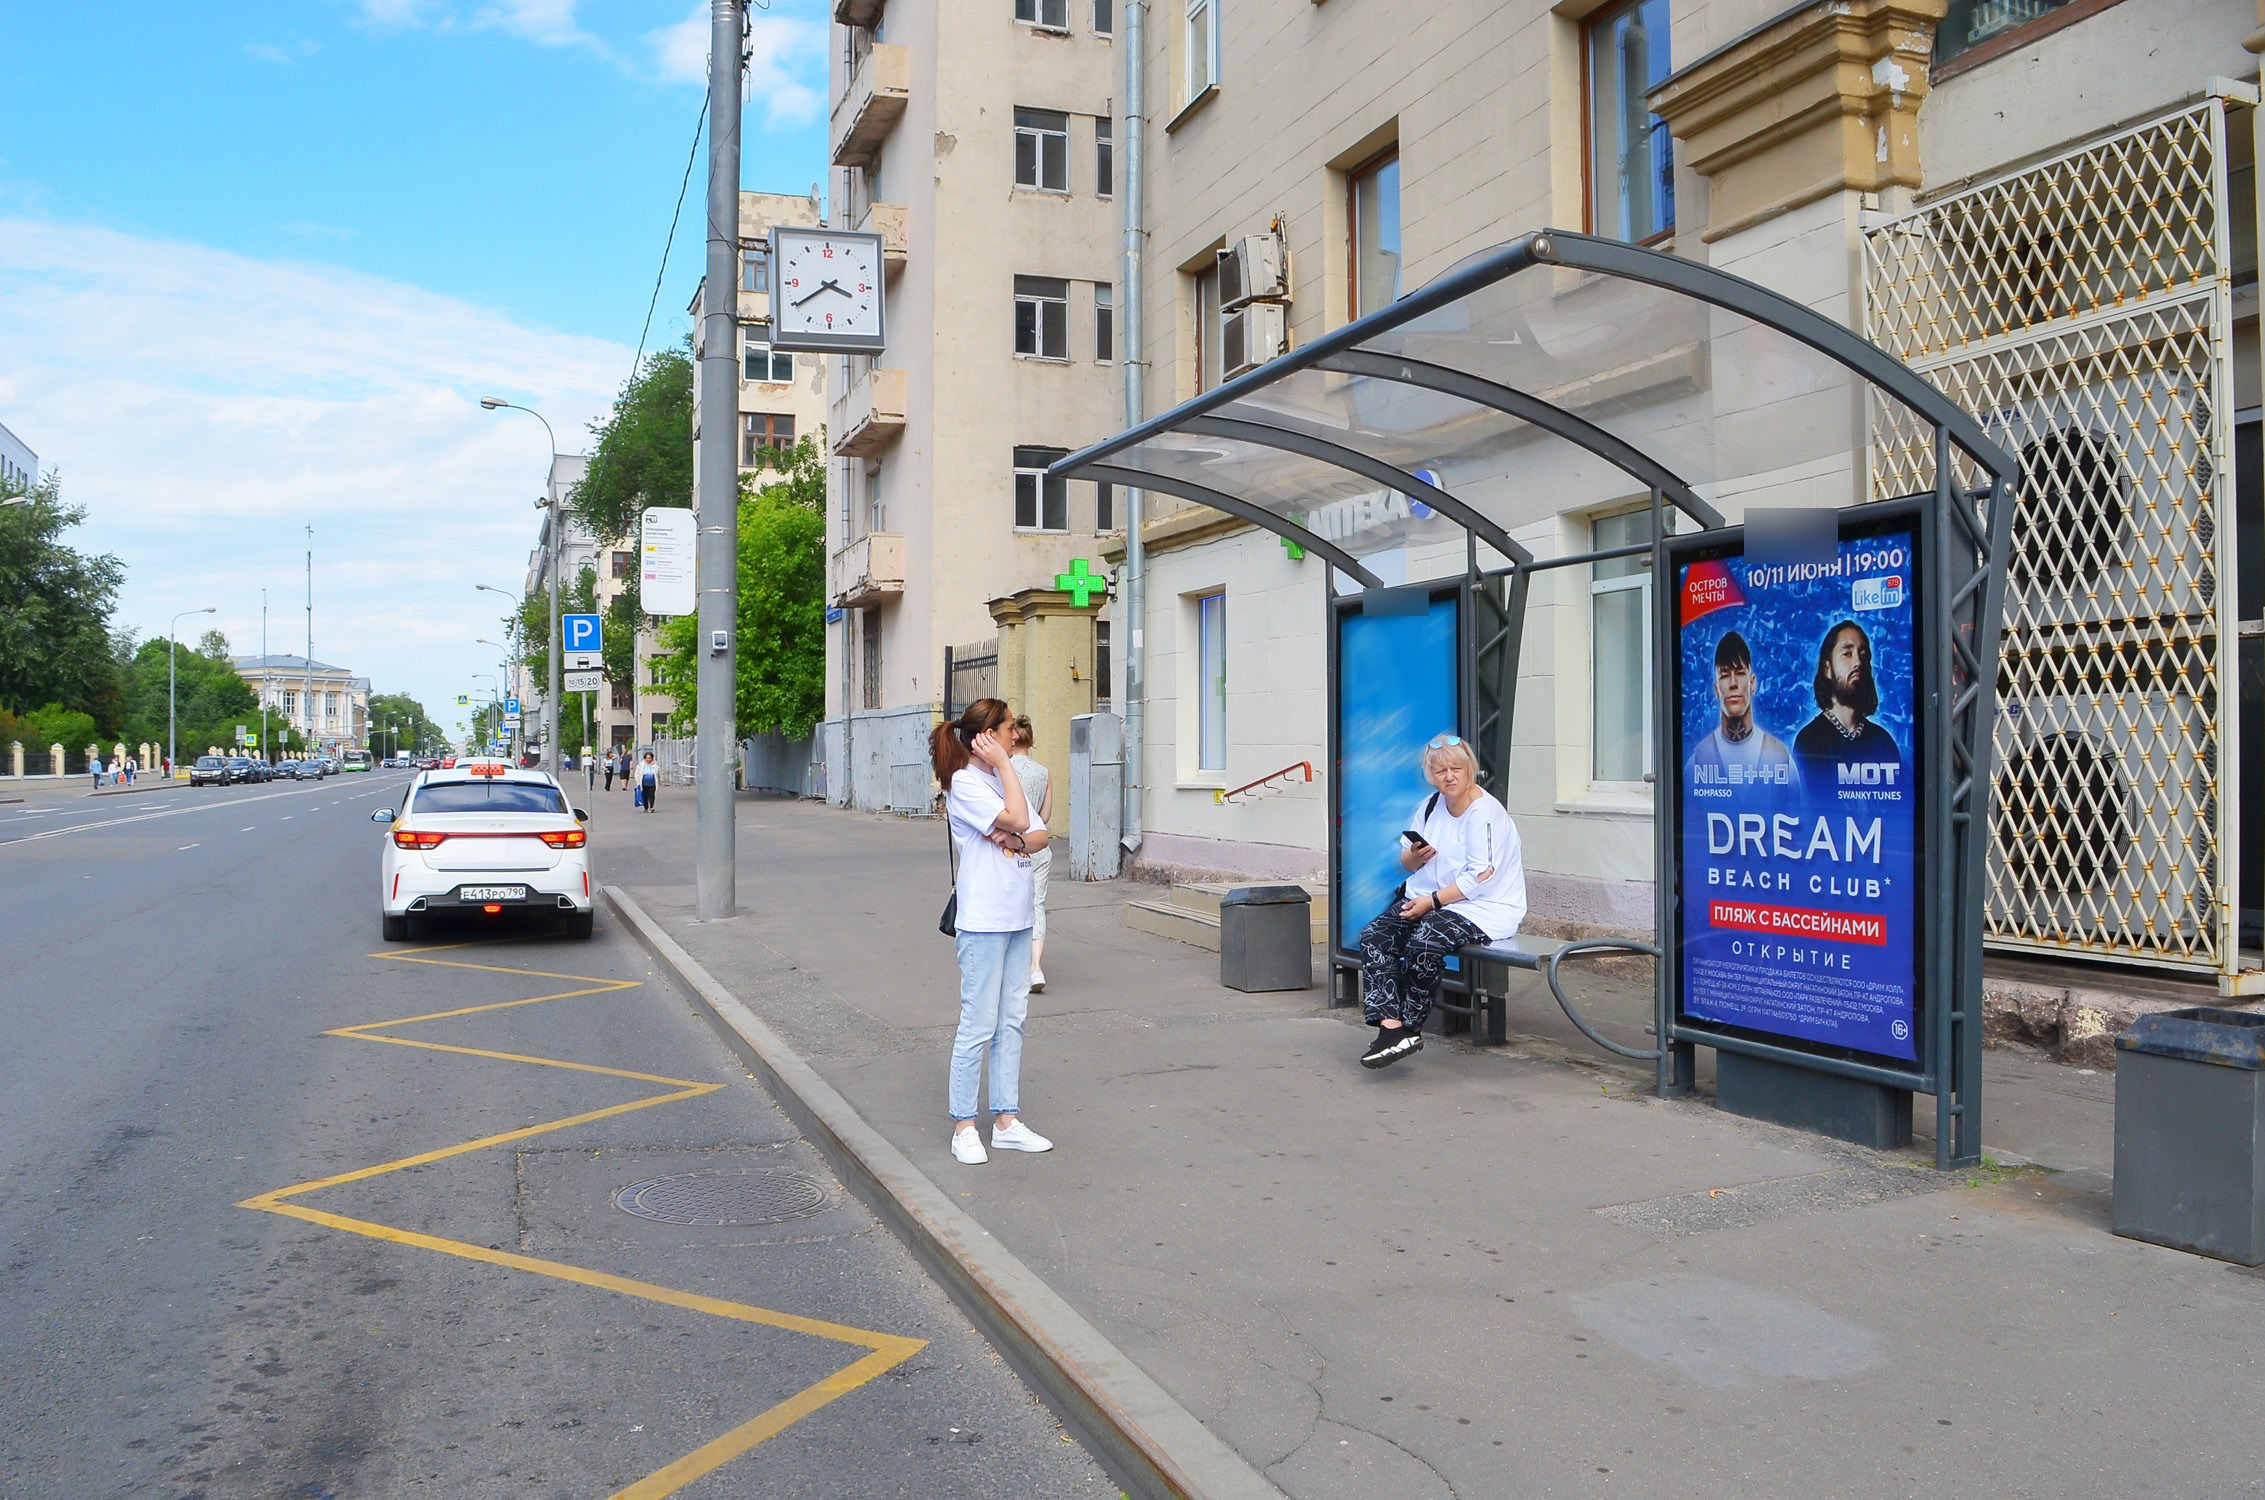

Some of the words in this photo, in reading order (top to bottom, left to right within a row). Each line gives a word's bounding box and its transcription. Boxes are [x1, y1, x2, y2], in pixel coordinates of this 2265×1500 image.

[822, 249, 833, 259] 12
[791, 278, 799, 287] 9
[858, 283, 865, 292] 3
[826, 314, 833, 322] 6
[1747, 566, 1784, 590] 10/11
[1787, 558, 1842, 582] ИЮНЯ
[1854, 548, 1903, 572] 19:00
[1689, 577, 1728, 592] ОСТРОВ
[1692, 590, 1725, 605] МЕЧТЫ
[573, 620, 593, 647] P
[587, 677, 598, 686] 20
[508, 701, 516, 712] P
[1694, 764, 1789, 784] NILETTO
[1694, 789, 1732, 797] ROMPASSO
[1838, 790, 1871, 800] SWANKY
[1872, 791, 1902, 800] TUNES
[1706, 812, 1882, 864] DREAM
[1708, 867, 1791, 891] BEACH
[1714, 905, 1757, 926] ПЛЯЖ
[1759, 911, 1770, 926] С
[1772, 910, 1880, 938] БАССЕЙНАМИ
[1732, 940, 1851, 970] ОТКРЫТИЕ
[1894, 1022, 1907, 1036] 16+
